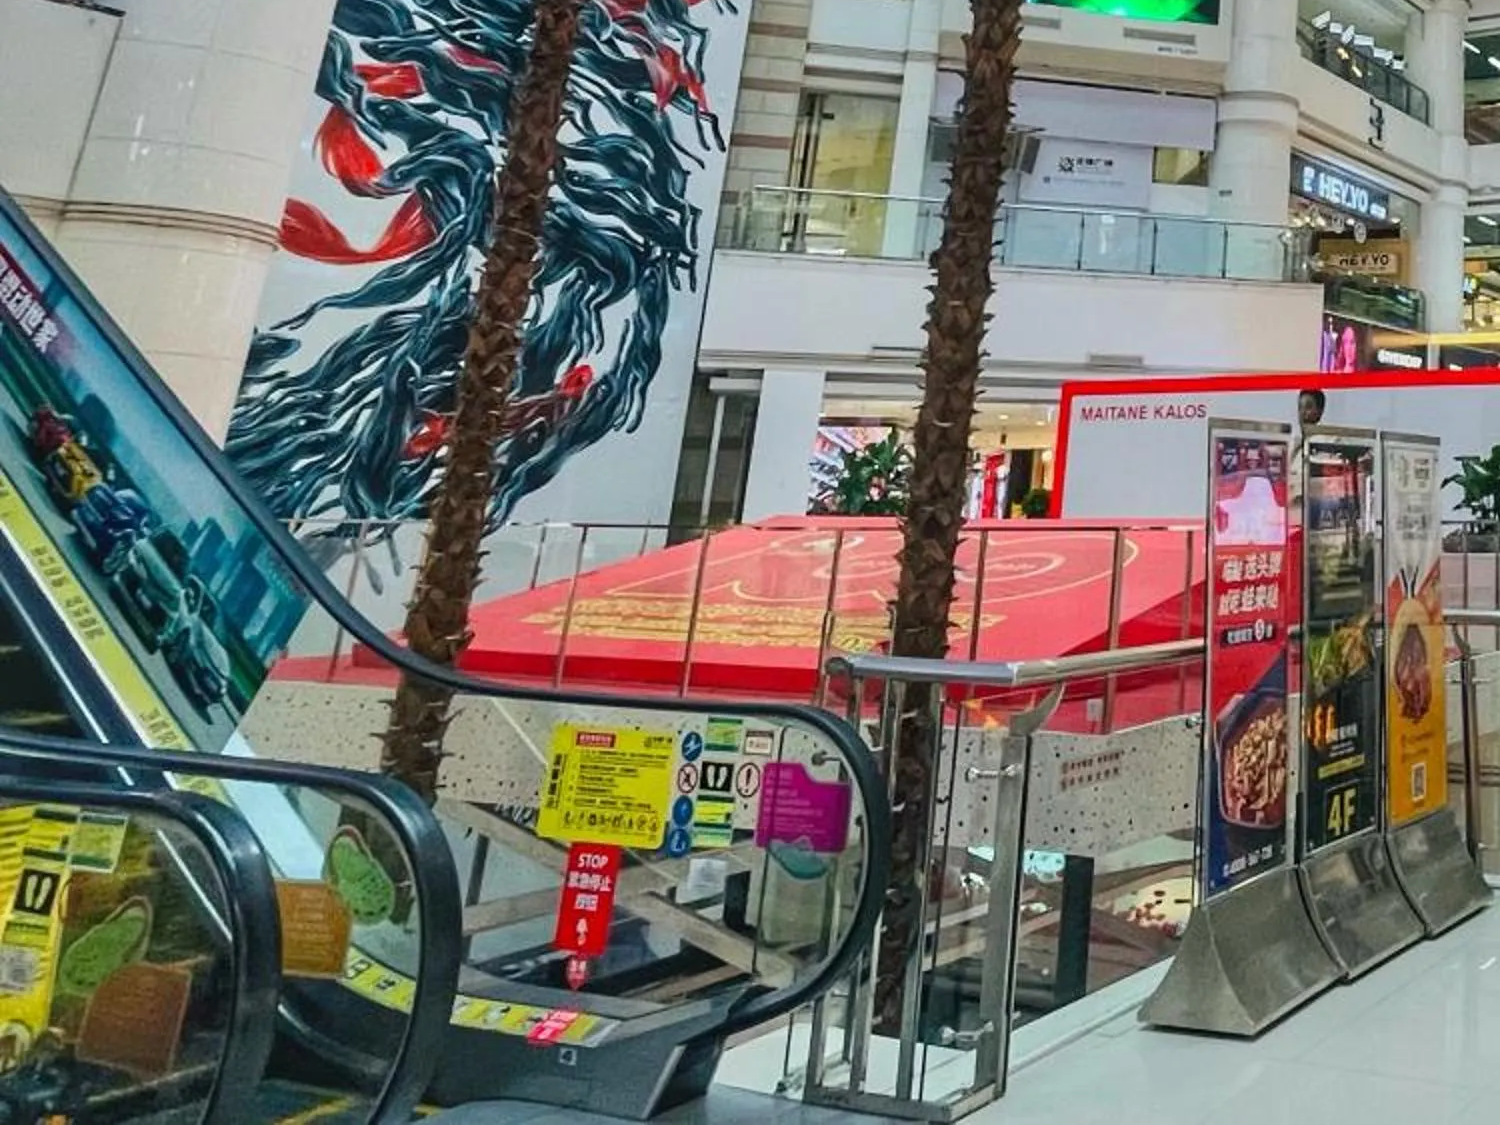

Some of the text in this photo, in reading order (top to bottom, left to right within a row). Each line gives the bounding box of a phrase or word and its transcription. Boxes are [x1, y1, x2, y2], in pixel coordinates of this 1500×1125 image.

[1081, 403, 1207, 421] MAITANE KALOS
[1328, 787, 1357, 837] 4F
[577, 852, 609, 869] STOP
